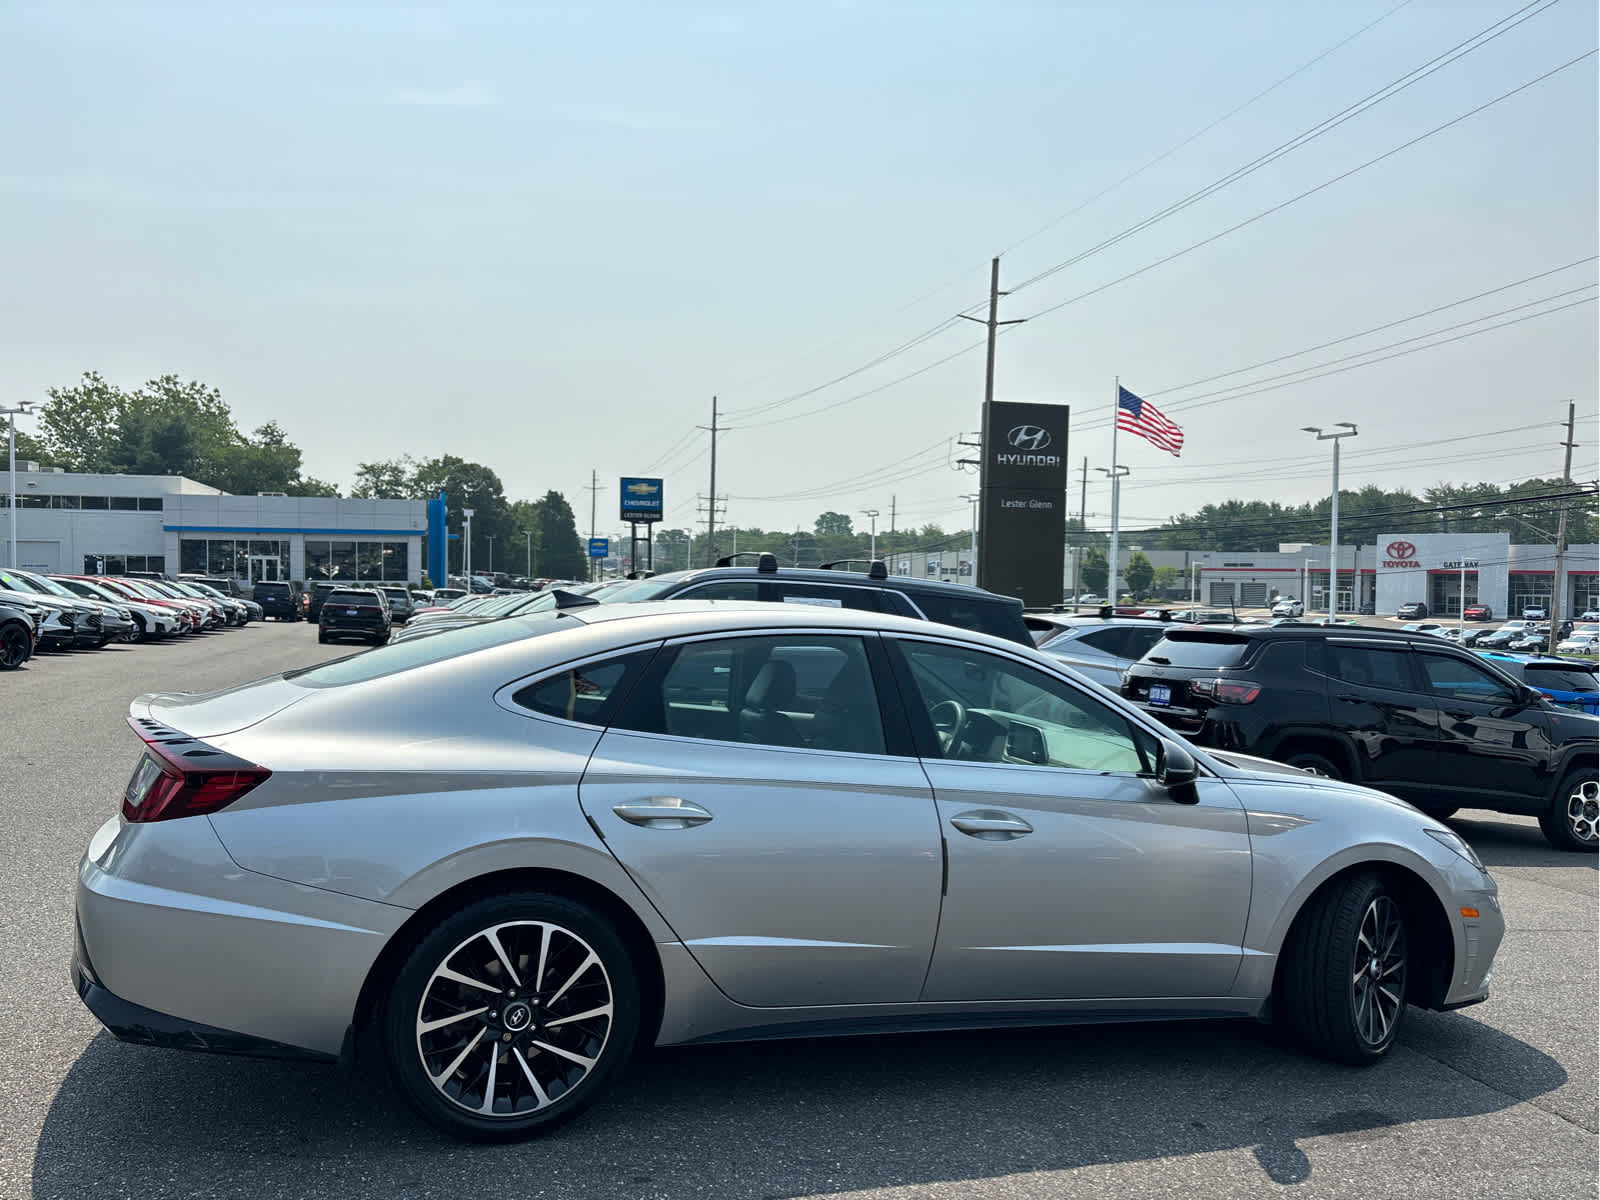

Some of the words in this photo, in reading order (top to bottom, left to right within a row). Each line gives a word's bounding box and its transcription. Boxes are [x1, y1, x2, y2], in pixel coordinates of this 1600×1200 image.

[997, 453, 1060, 467] HYUNDAI
[1000, 499, 1027, 508] Lester
[1029, 499, 1053, 509] Glenn
[1382, 560, 1421, 568] TOYOTA
